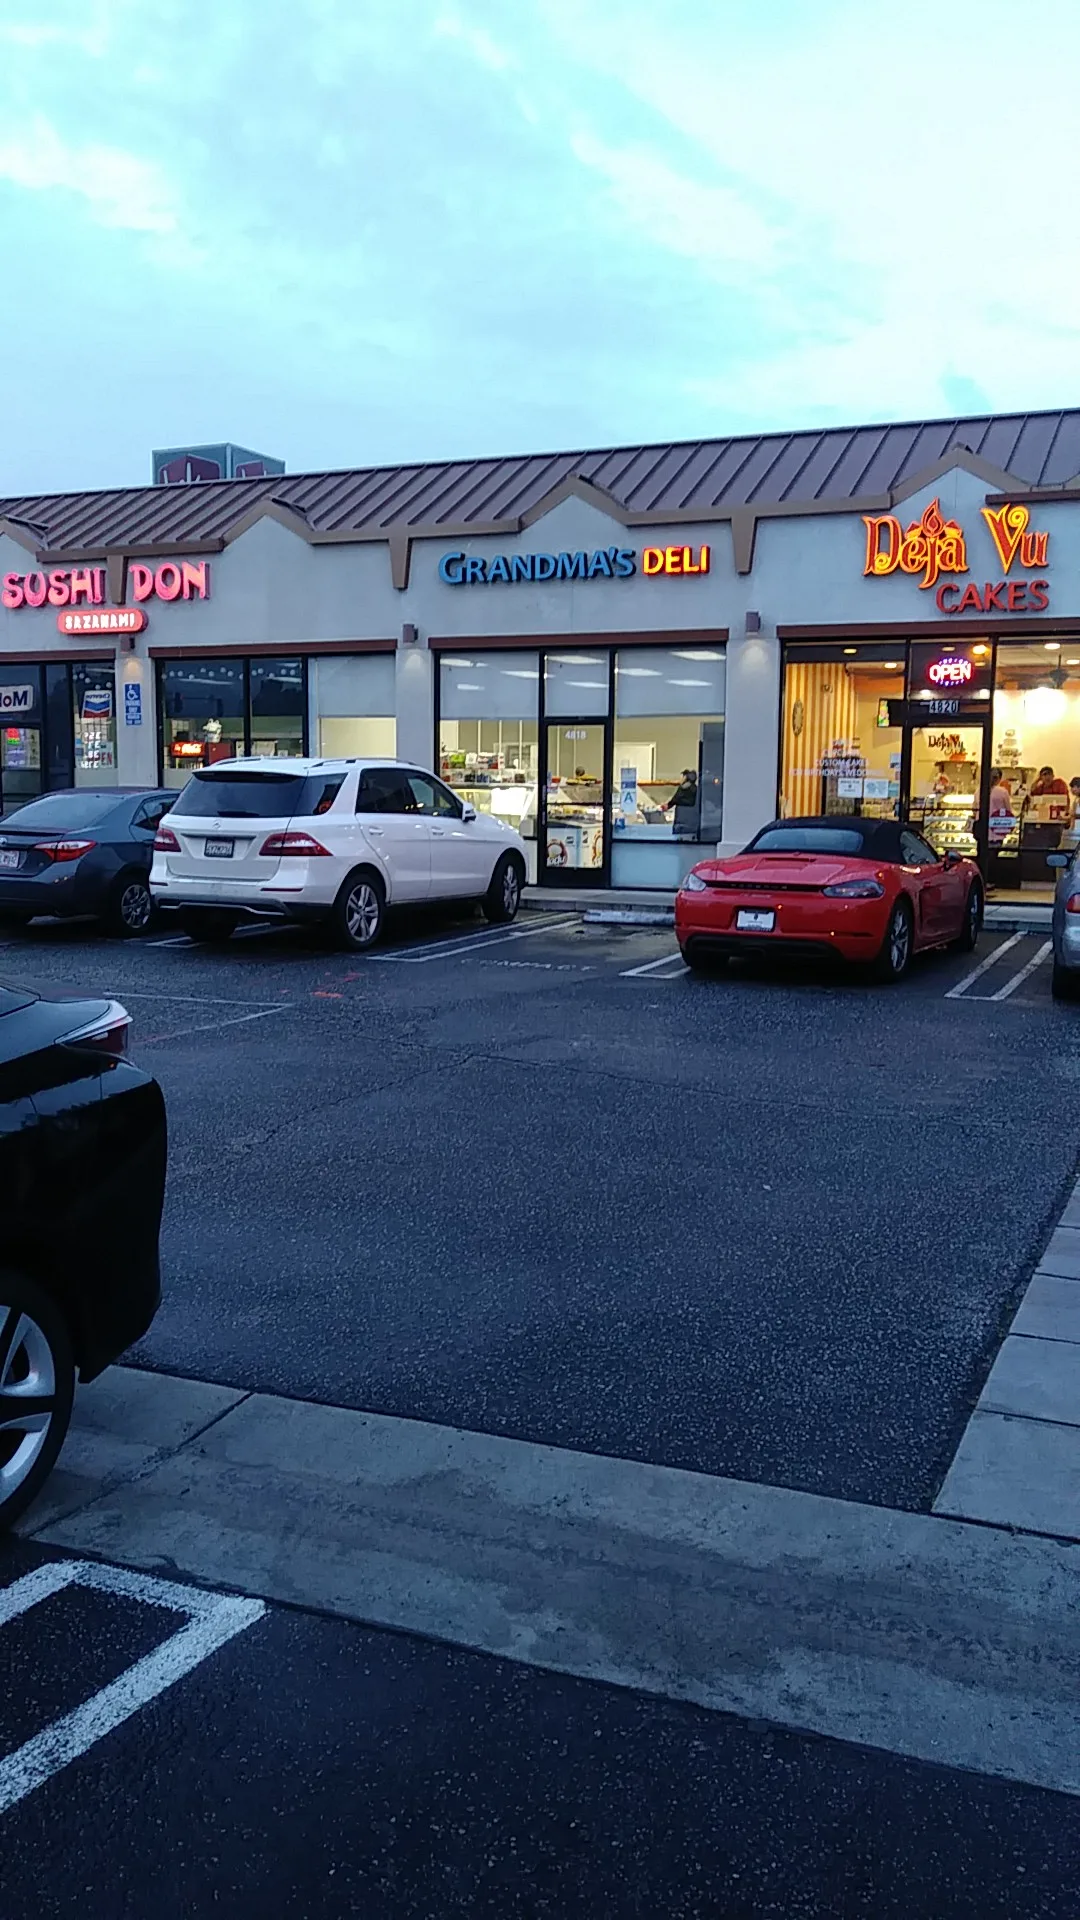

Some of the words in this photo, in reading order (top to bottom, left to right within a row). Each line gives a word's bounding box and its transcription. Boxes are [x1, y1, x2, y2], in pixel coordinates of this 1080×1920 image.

[981, 503, 1049, 575] Vu
[642, 545, 710, 575] DELI
[1, 567, 106, 609] SUSHI
[129, 560, 209, 602] DON
[935, 580, 1050, 614] CAKES
[65, 612, 135, 630] SAZANAMI
[929, 662, 972, 681] OPEN
[929, 700, 958, 713] 4820
[564, 729, 587, 741] 4818
[623, 791, 633, 803] A
